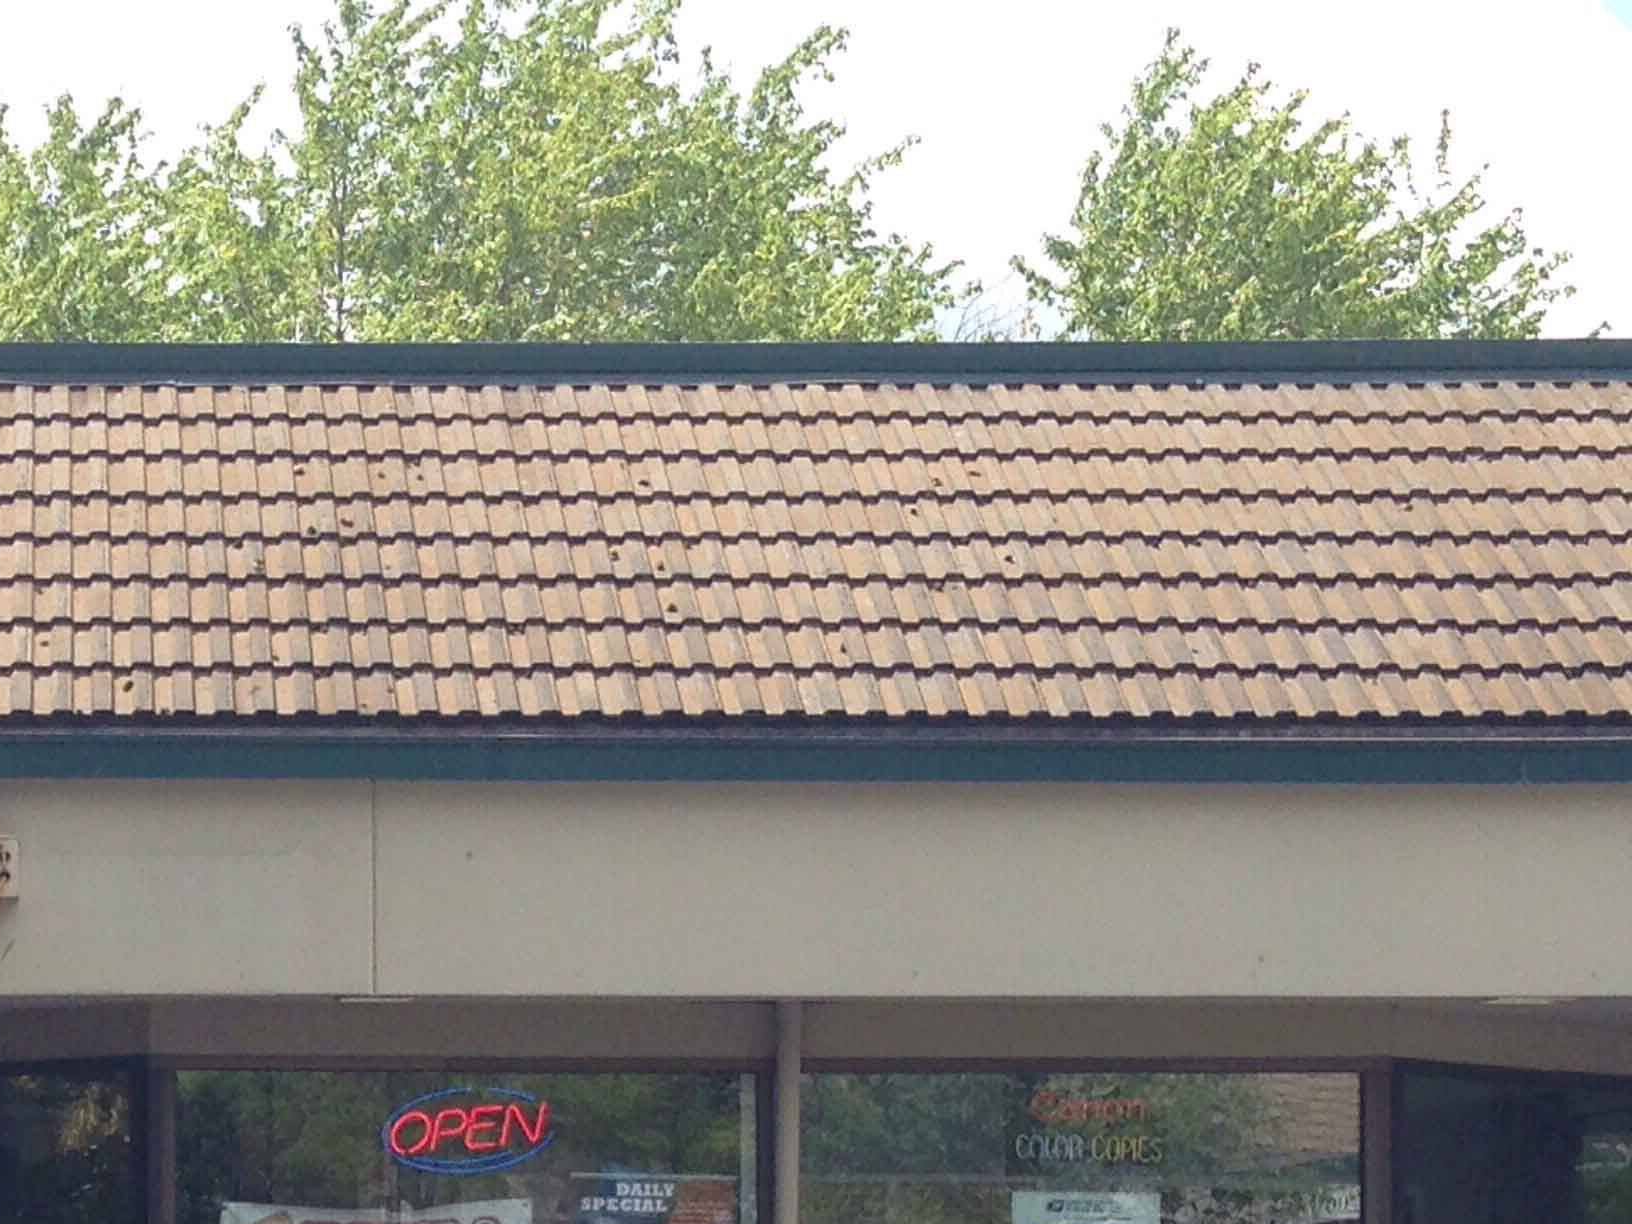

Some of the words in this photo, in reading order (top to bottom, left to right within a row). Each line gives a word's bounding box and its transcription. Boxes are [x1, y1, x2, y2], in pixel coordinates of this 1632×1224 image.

[389, 1101, 551, 1157] OPEN
[1090, 1134, 1163, 1163] COPIES
[616, 1182, 675, 1198] DAILY
[580, 1197, 668, 1213] SPECIAL
